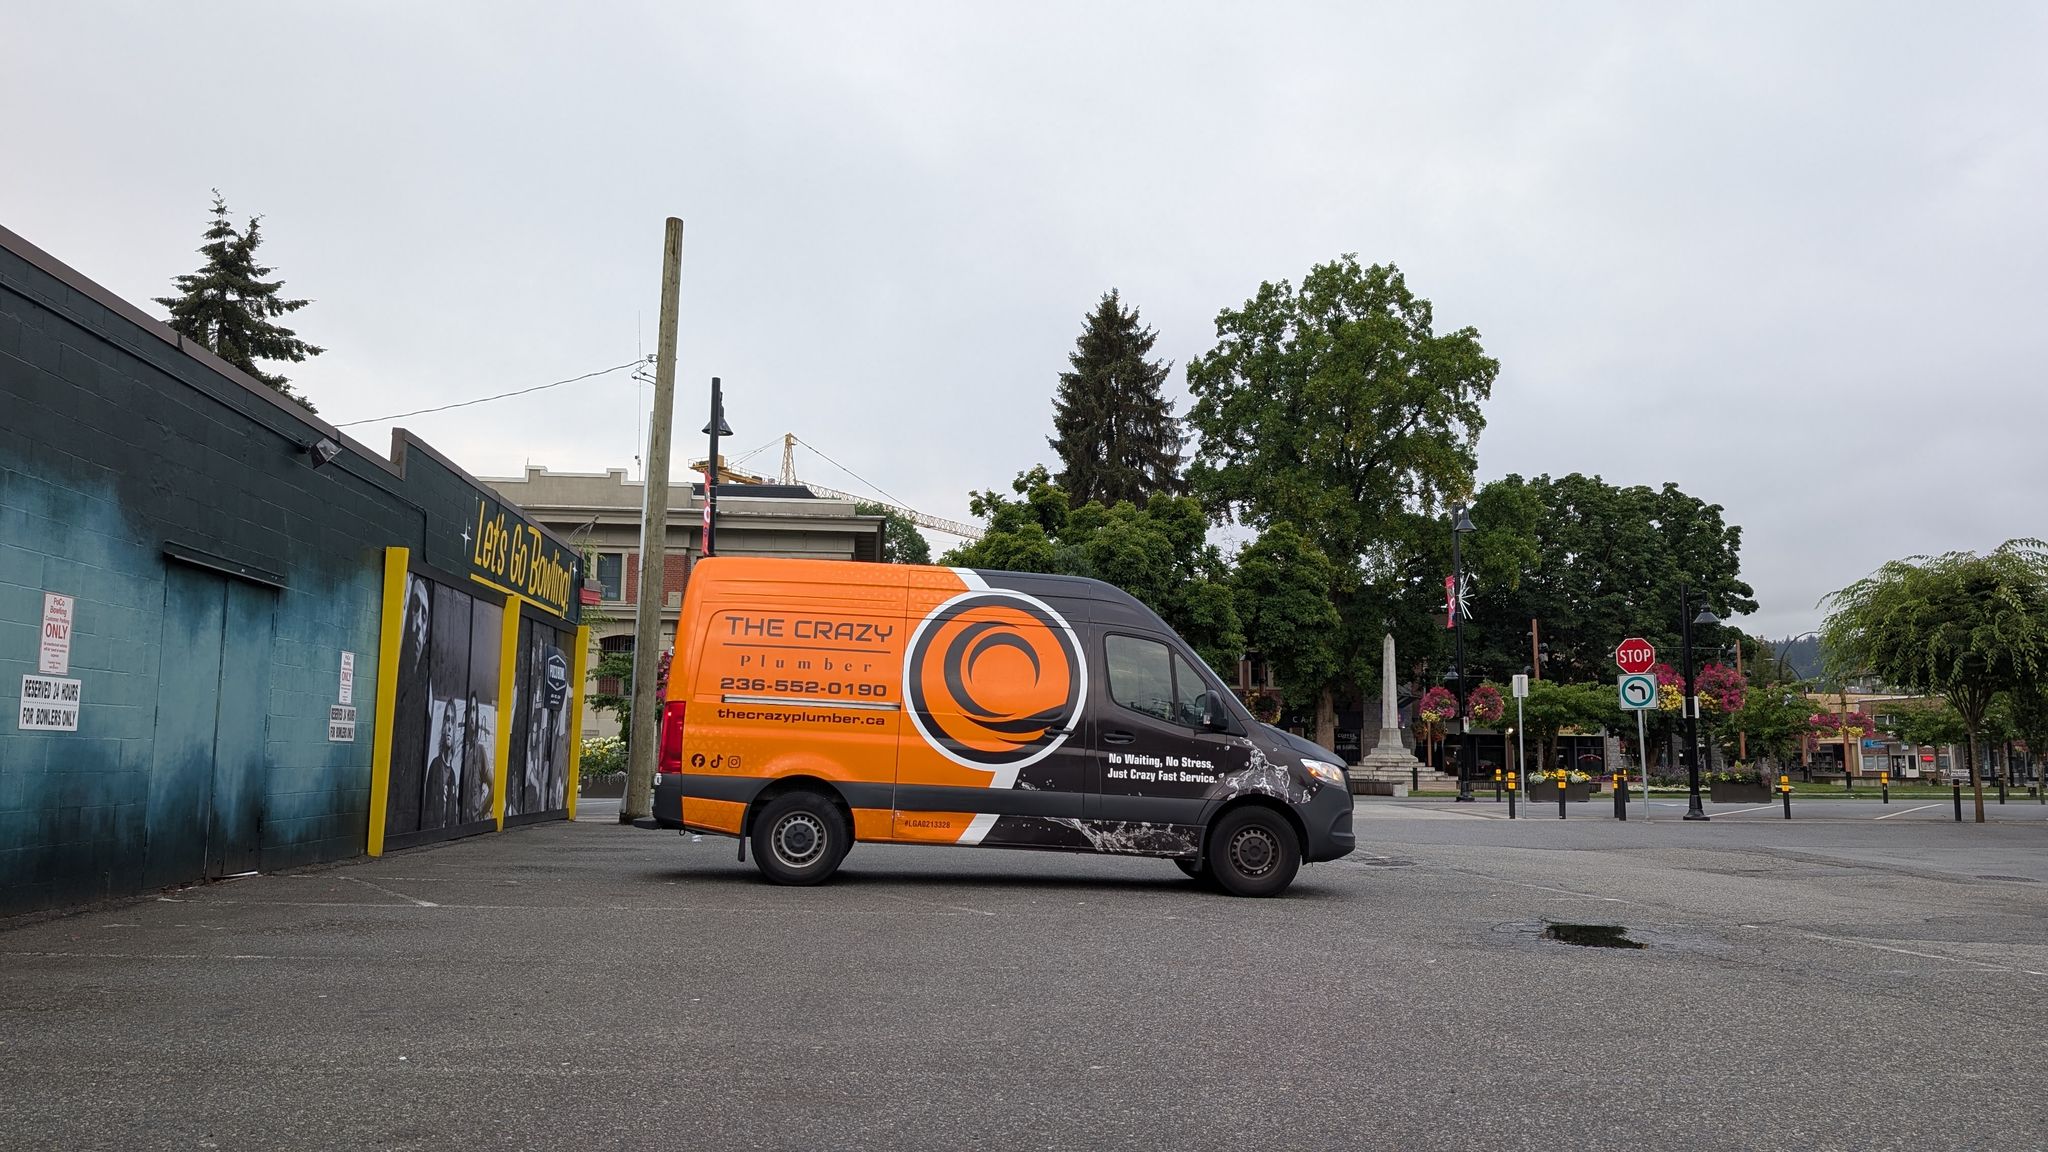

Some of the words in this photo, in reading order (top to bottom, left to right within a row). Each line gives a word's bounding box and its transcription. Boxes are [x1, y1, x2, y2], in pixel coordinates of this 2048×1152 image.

[475, 501, 508, 576] Let's
[510, 523, 528, 587] Go
[527, 525, 573, 619] Bowling!
[53, 597, 65, 607] PoCo
[49, 606, 67, 617] Bowling
[45, 623, 68, 640] ONLY
[725, 616, 785, 637] THE
[794, 620, 893, 643] CRAZY
[740, 654, 872, 673] Plumber
[1620, 648, 1651, 664] STOP
[24, 679, 51, 699] RESERVED
[53, 682, 60, 700] 24
[61, 683, 79, 701] HOURS
[720, 677, 887, 697] 236-552-0190
[22, 707, 34, 725] FOR
[36, 708, 61, 726] BOWLERS
[62, 710, 77, 727] ONLY
[717, 708, 885, 726] thecrazyplumber.ca
[1108, 753, 1122, 764] No
[1124, 754, 1163, 768] Waiting,
[1165, 756, 1179, 767] No
[1181, 757, 1214, 769] Stress.
[1107, 768, 1128, 779] Just
[1130, 769, 1156, 782] Crazy
[1158, 770, 1178, 781] Fast
[1179, 771, 1218, 783] Service.
